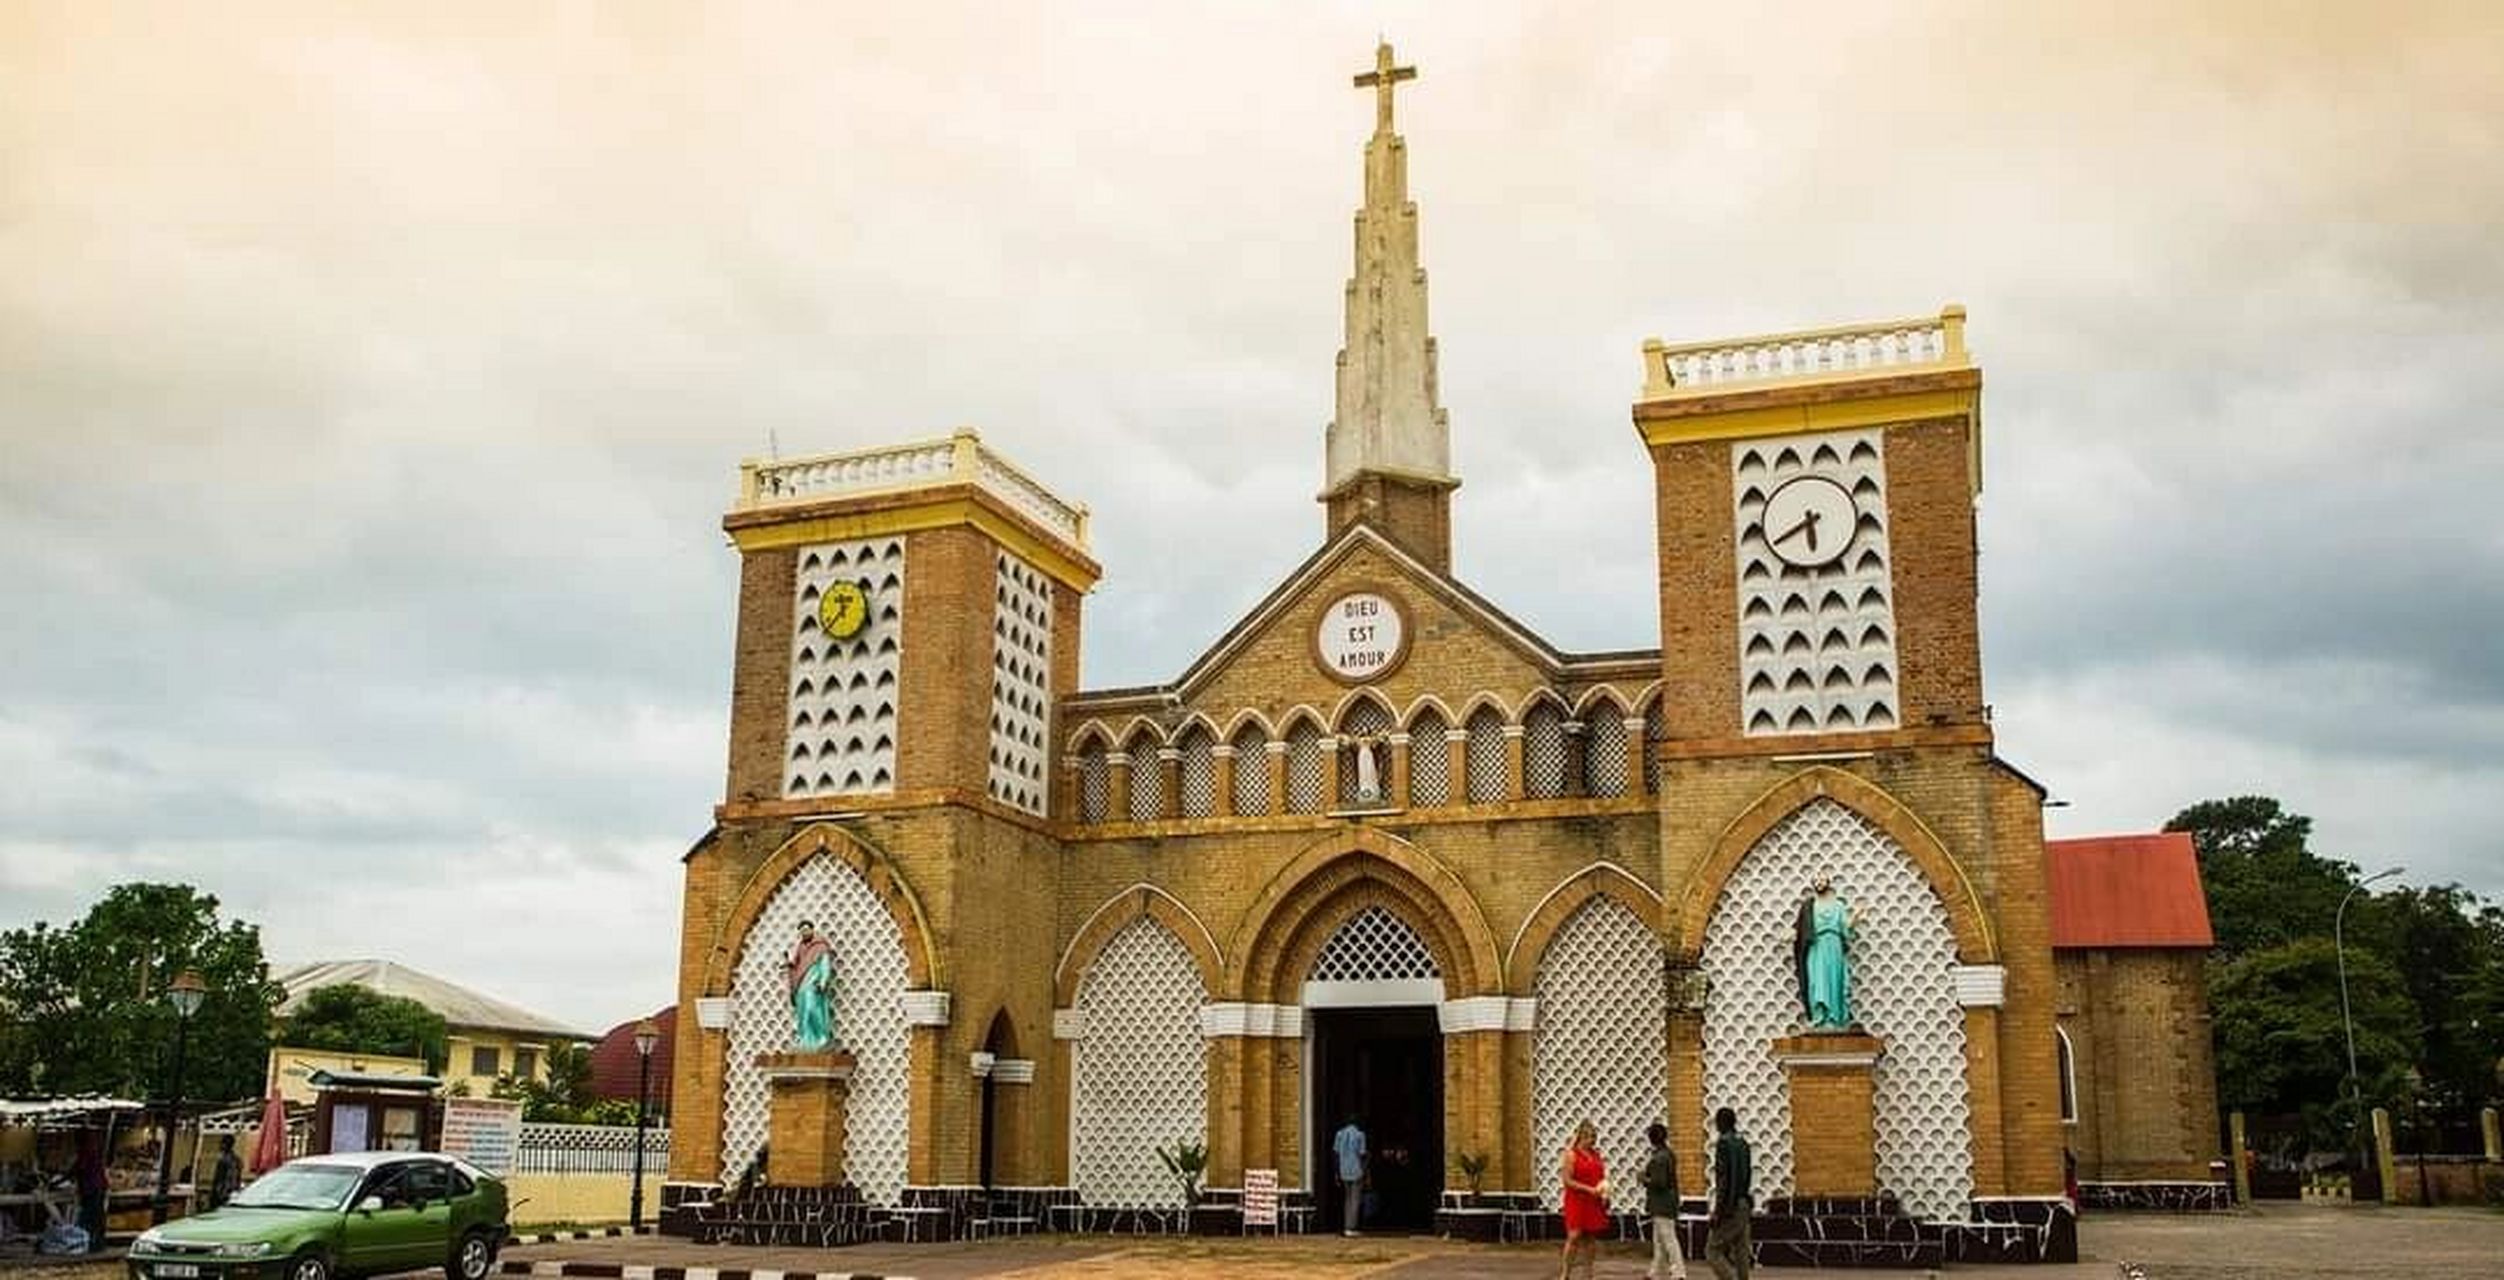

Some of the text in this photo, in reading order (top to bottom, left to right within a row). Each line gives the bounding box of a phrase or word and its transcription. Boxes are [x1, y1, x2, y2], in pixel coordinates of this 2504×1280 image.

[1344, 600, 1379, 618] DIEU
[1348, 626, 1375, 643] EST
[1339, 650, 1386, 668] AMOUR
